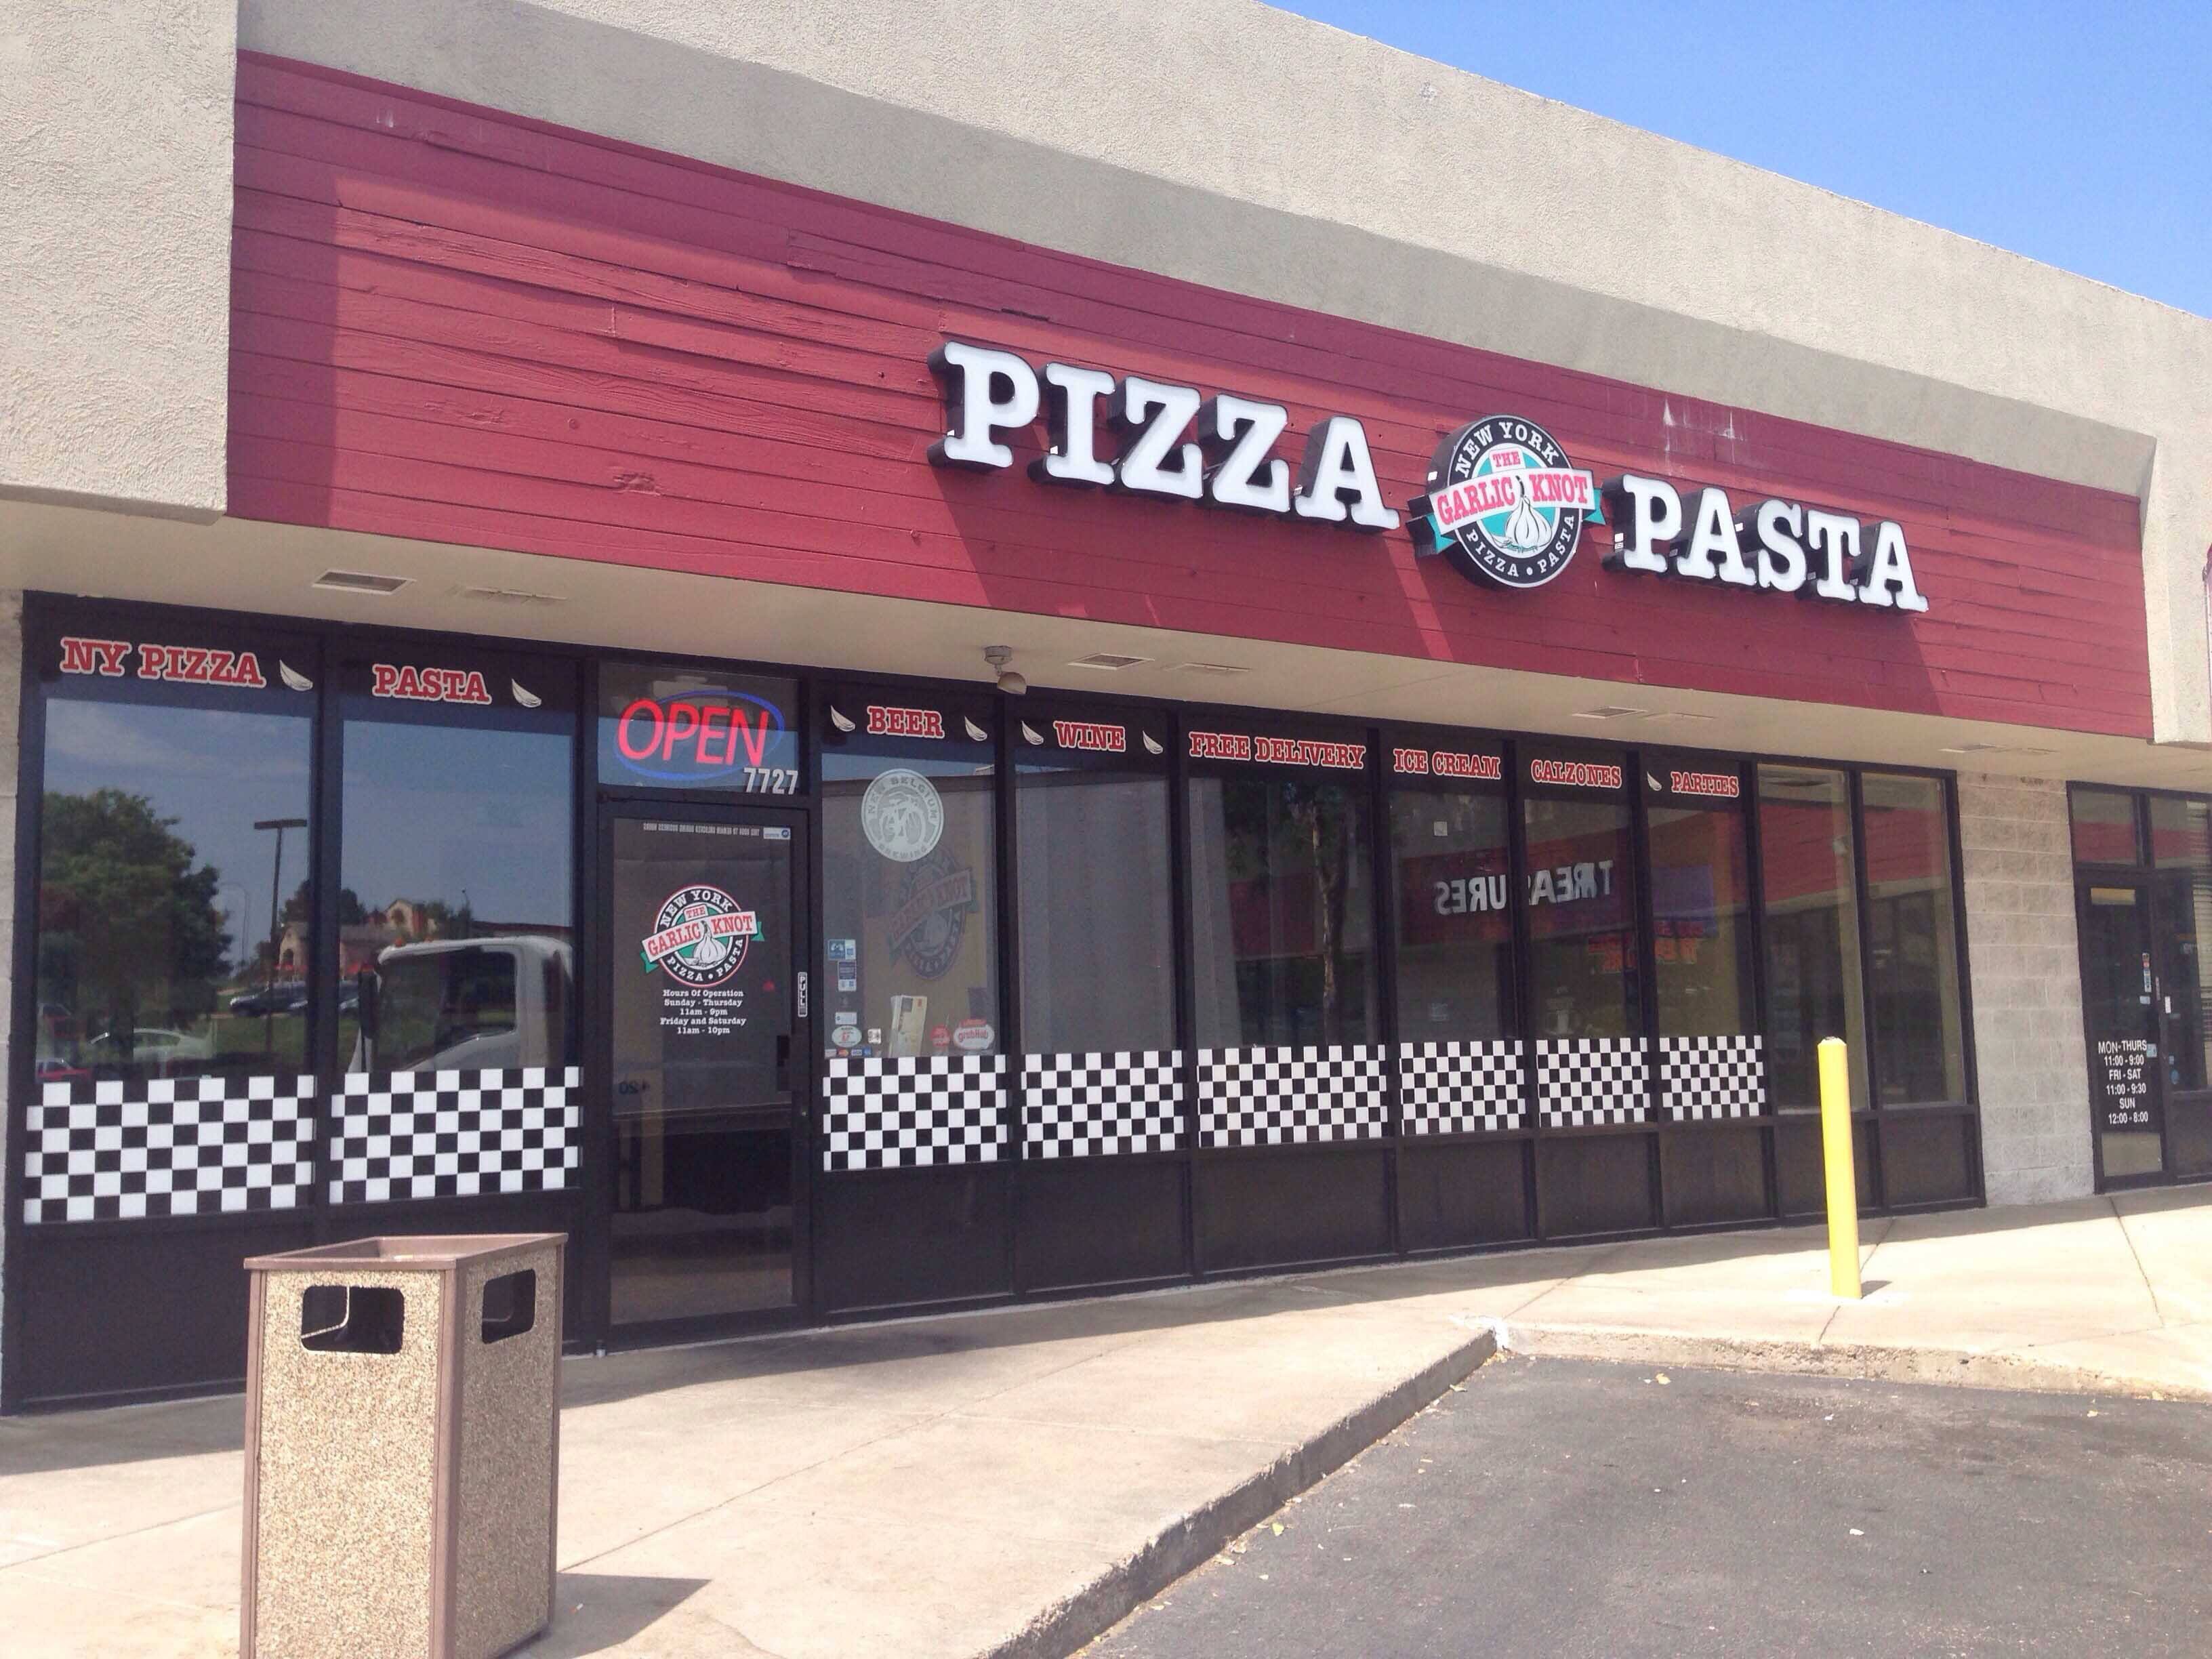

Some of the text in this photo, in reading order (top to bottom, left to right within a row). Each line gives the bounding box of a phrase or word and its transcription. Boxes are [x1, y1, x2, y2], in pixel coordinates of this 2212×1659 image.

[944, 342, 1400, 531] PIZZA
[1455, 422, 1559, 478] NEW YORK
[1492, 451, 1521, 468] THE
[1437, 474, 1588, 525] GARLIC KNOT
[1466, 514, 1575, 577] PIZZA PASTA
[1620, 474, 1929, 612] PASTA
[60, 636, 267, 689] NY PIZZA
[371, 663, 492, 705] PASTA
[617, 697, 770, 767] OPEN
[867, 705, 945, 739] BEER
[1053, 720, 1126, 753] WINE
[1189, 731, 1366, 770] FREE DELIVERY
[1393, 748, 1502, 780] ICE CREAM
[743, 767, 799, 795] 7727
[1530, 758, 1622, 789] CALZONES
[1671, 771, 1740, 798] PARTIES
[890, 775, 939, 819] BELGIUM
[660, 889, 733, 927] NEW YORK
[686, 906, 705, 919] THE
[648, 916, 752, 956] GARLIC KNOT
[666, 939, 743, 981] PIZZA PASTA
[664, 999, 696, 1007] Sunday
[703, 999, 743, 1007] Thursday
[703, 989, 744, 998] Operation
[660, 1017, 689, 1026] Friday
[708, 1017, 746, 1026] Saturday
[710, 1008, 728, 1017] 9pm
[708, 1027, 731, 1036] 10pm
[2104, 1055, 2123, 1067] 11:00
[2129, 1054, 2144, 1065] 9:00
[2109, 1069, 2122, 1081] FRI
[2127, 1068, 2142, 1080] SAT
[2106, 1084, 2126, 1095] 11:00
[2131, 1082, 2147, 1094] 9:30
[2119, 1097, 2135, 1109] SUN
[2108, 1112, 2128, 1124] 12:00
[2133, 1111, 2148, 1123] 8:00
